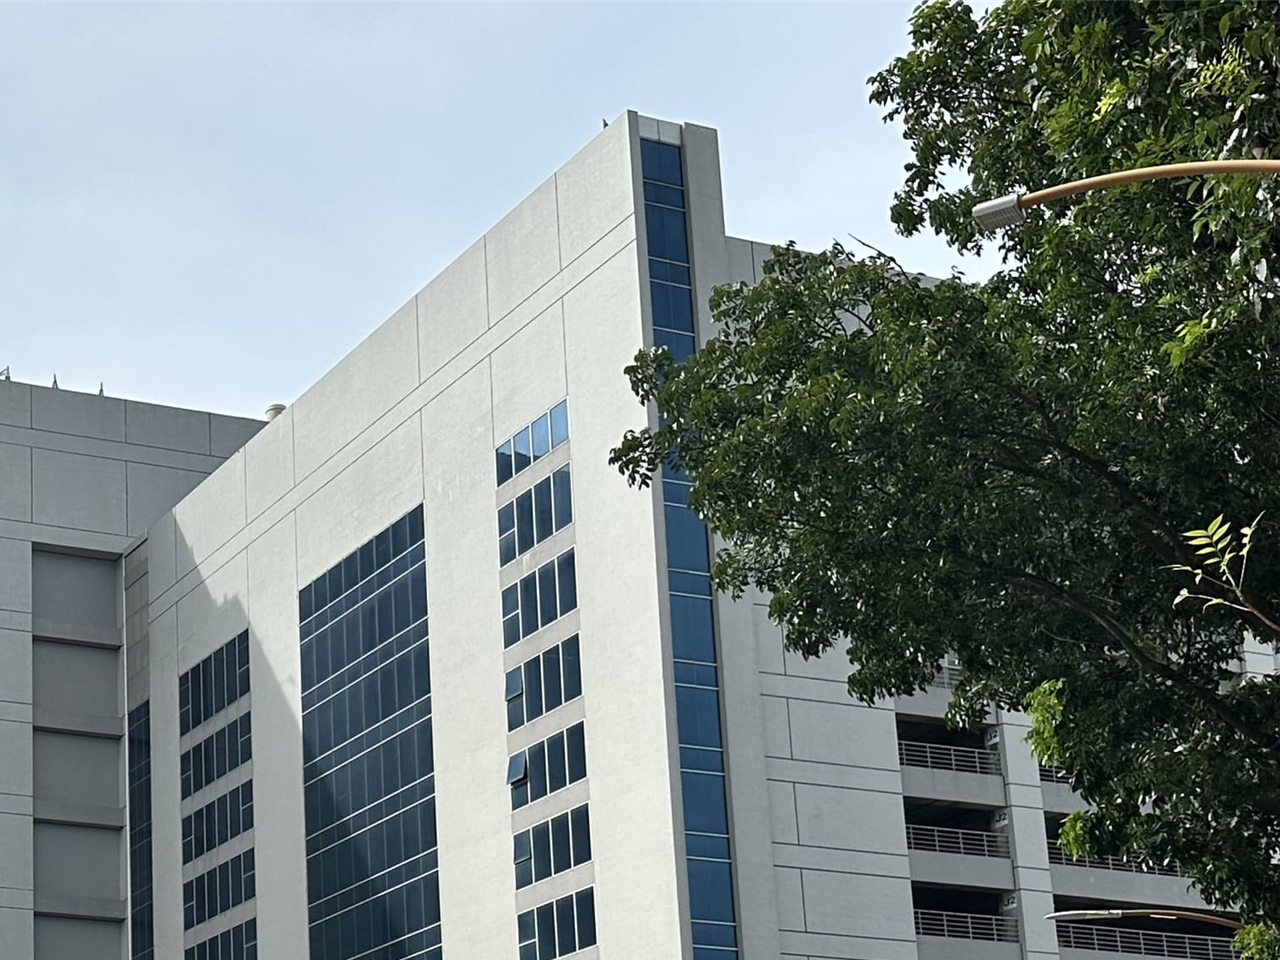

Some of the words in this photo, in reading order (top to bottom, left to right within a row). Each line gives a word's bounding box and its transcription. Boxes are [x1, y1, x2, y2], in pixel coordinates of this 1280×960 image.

[986, 729, 998, 742] J2
[995, 812, 1008, 823] J2
[1003, 896, 1016, 907] J2
